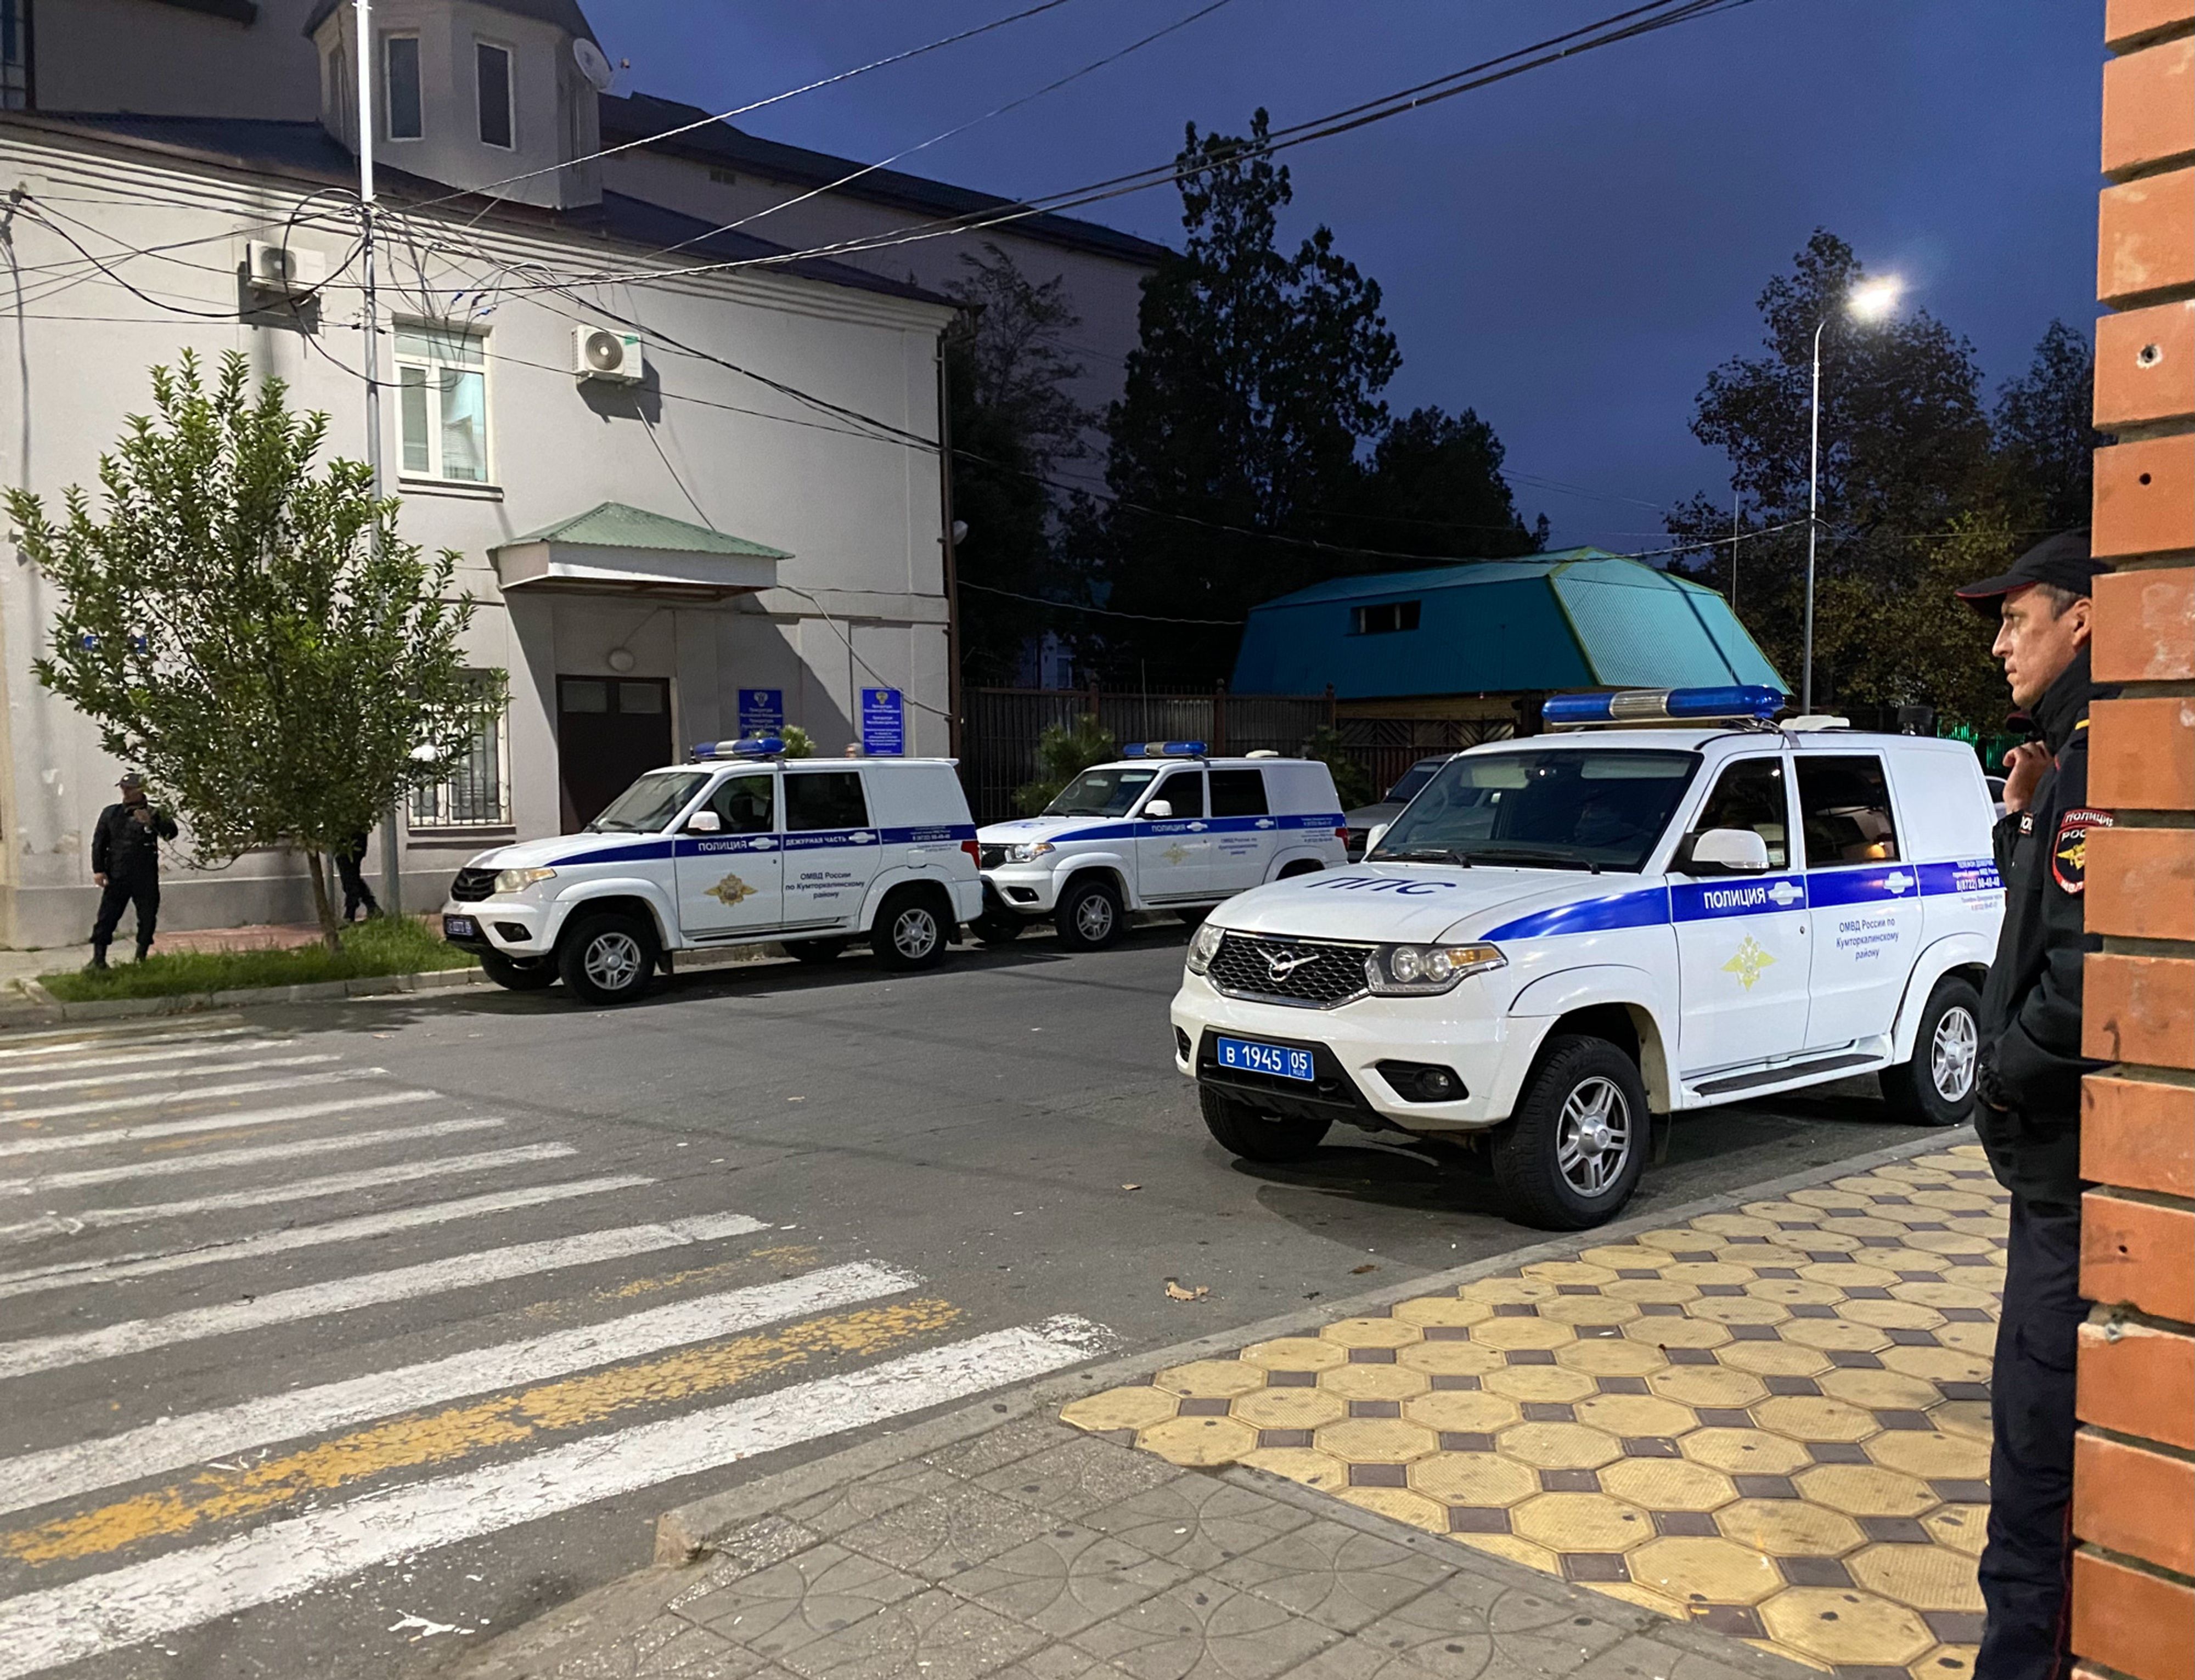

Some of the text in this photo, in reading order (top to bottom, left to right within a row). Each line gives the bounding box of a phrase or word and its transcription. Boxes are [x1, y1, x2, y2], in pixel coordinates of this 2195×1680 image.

[1151, 824, 1186, 832] ПОЛИЦИЯ
[2061, 829, 2086, 842] РОС
[698, 841, 747, 851] ПОЛИЦИЯ
[786, 838, 823, 847] ДЕЖУРНАЯ
[1305, 877, 1456, 894] ППС
[1703, 888, 1766, 909] ПОЛИЦИЯ
[1839, 921, 1861, 932] ОМВД
[1862, 920, 1886, 929] России
[1836, 933, 1899, 950] Кумторкалинскому
[1855, 949, 1879, 961] району
[1226, 1045, 1308, 1071] В 1945 05
[1292, 1068, 1305, 1077] RUS
